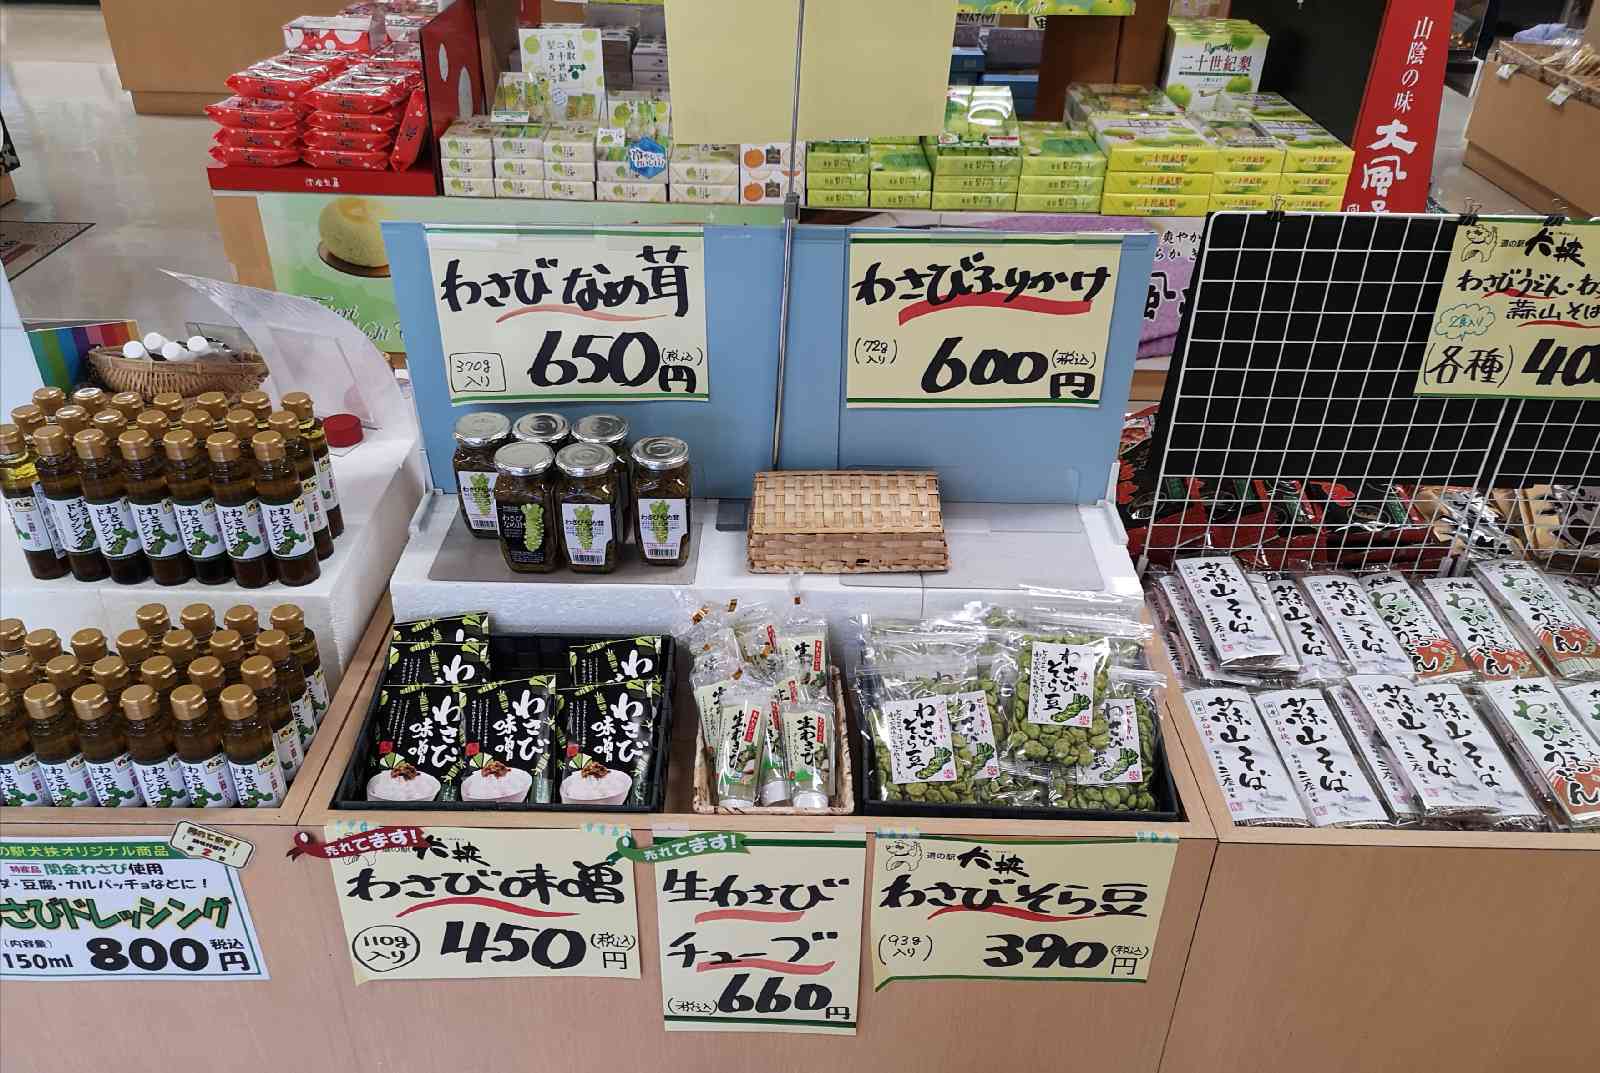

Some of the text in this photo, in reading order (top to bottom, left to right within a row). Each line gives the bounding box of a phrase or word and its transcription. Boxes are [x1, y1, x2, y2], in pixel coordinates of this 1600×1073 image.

[1181, 55, 1252, 72] 二十世紀梨
[1394, 16, 1434, 114] 山陰の味
[440, 245, 689, 317] わさびなめ茸
[852, 252, 1111, 306] わさびふりかけ
[1457, 268, 1600, 297] わさびうどん・わ
[797, 715, 816, 766] 生わさび
[927, 851, 957, 861] 道の駅
[346, 863, 625, 905] わさび味噌
[663, 868, 850, 909] 生わさび
[880, 873, 1147, 918] わさびそら豆
[0, 897, 232, 930] さびドレッシング
[3, 953, 74, 970] 150ml
[667, 931, 839, 968] チューブ
